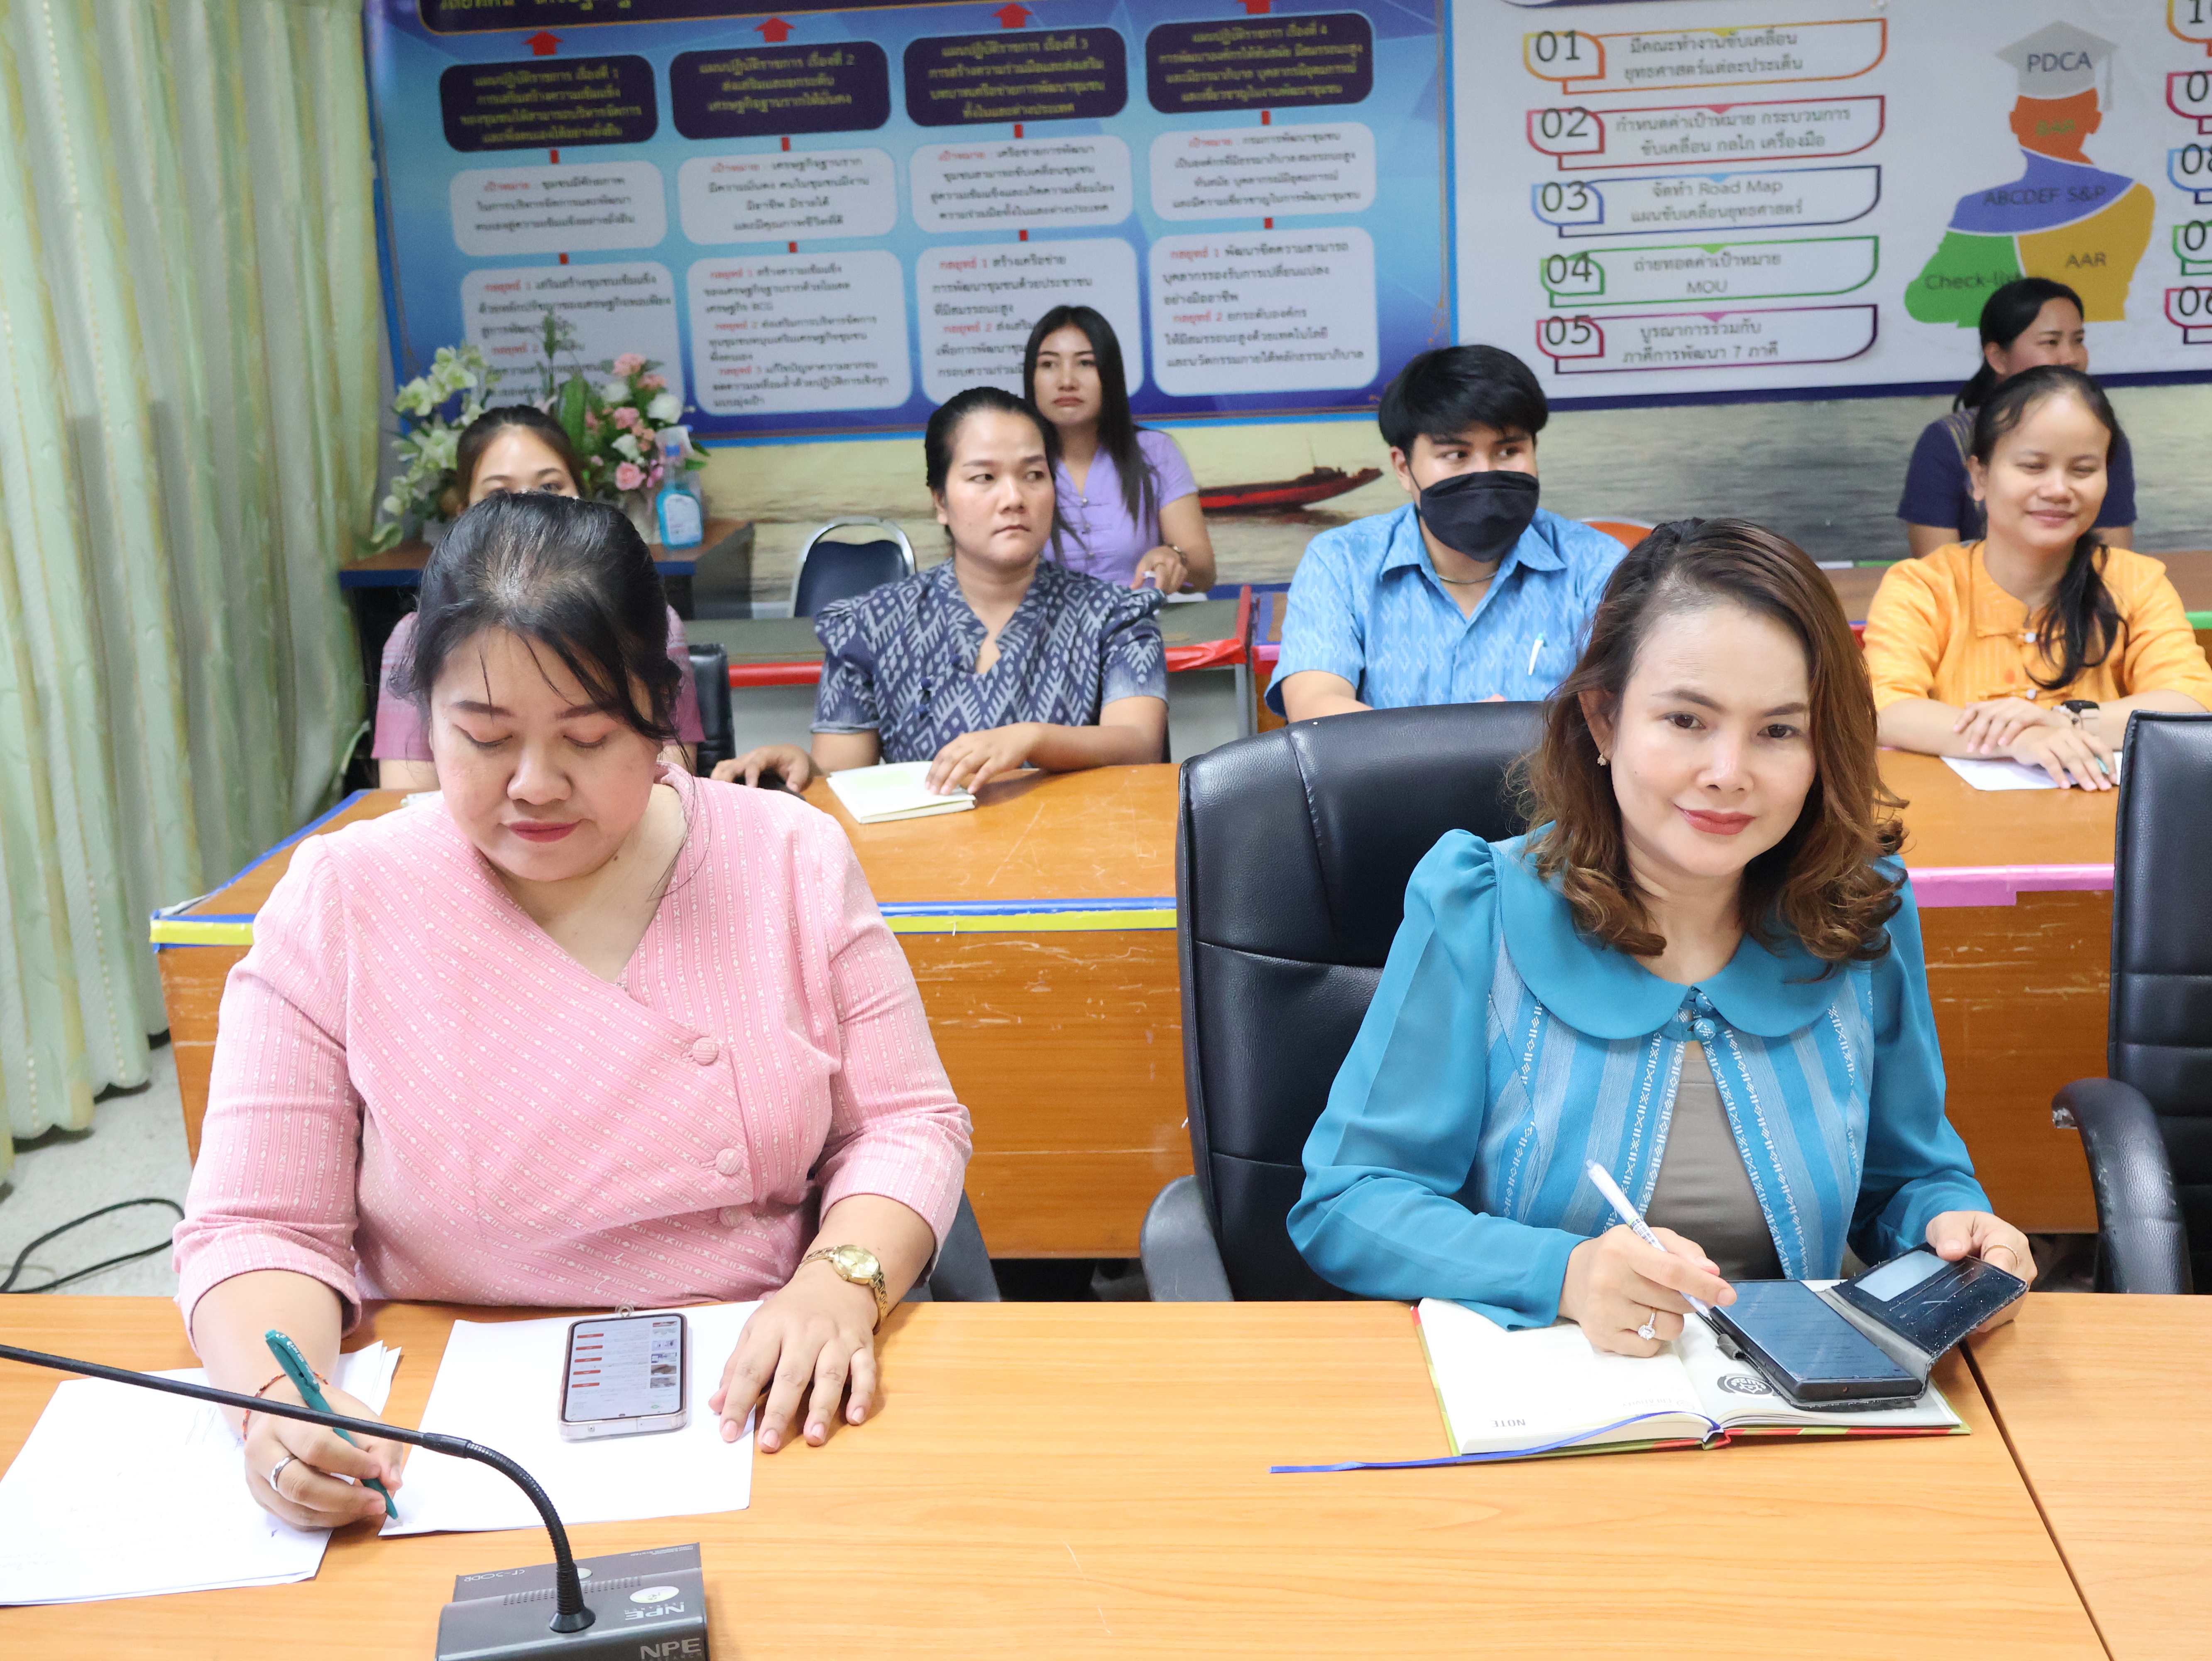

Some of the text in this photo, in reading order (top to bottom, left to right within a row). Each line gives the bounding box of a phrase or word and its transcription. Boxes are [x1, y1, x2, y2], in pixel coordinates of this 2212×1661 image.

[1536, 30, 1581, 62] 01
[2027, 51, 2093, 72] PDCA
[1541, 106, 1589, 139] 02
[1542, 181, 1588, 212] 03
[1699, 179, 1741, 195] Road
[1747, 179, 1783, 197] Map
[1983, 185, 2107, 206] ABCDEF S&P
[1546, 252, 1592, 284] 04
[2065, 252, 2107, 268] AAR
[1686, 280, 1728, 294] MOU
[1546, 315, 1591, 345] 05
[1733, 345, 1743, 358] 7
[1491, 1418, 1526, 1428] NOTE
[624, 1605, 685, 1620] NPE
[640, 1638, 701, 1660] NPE
